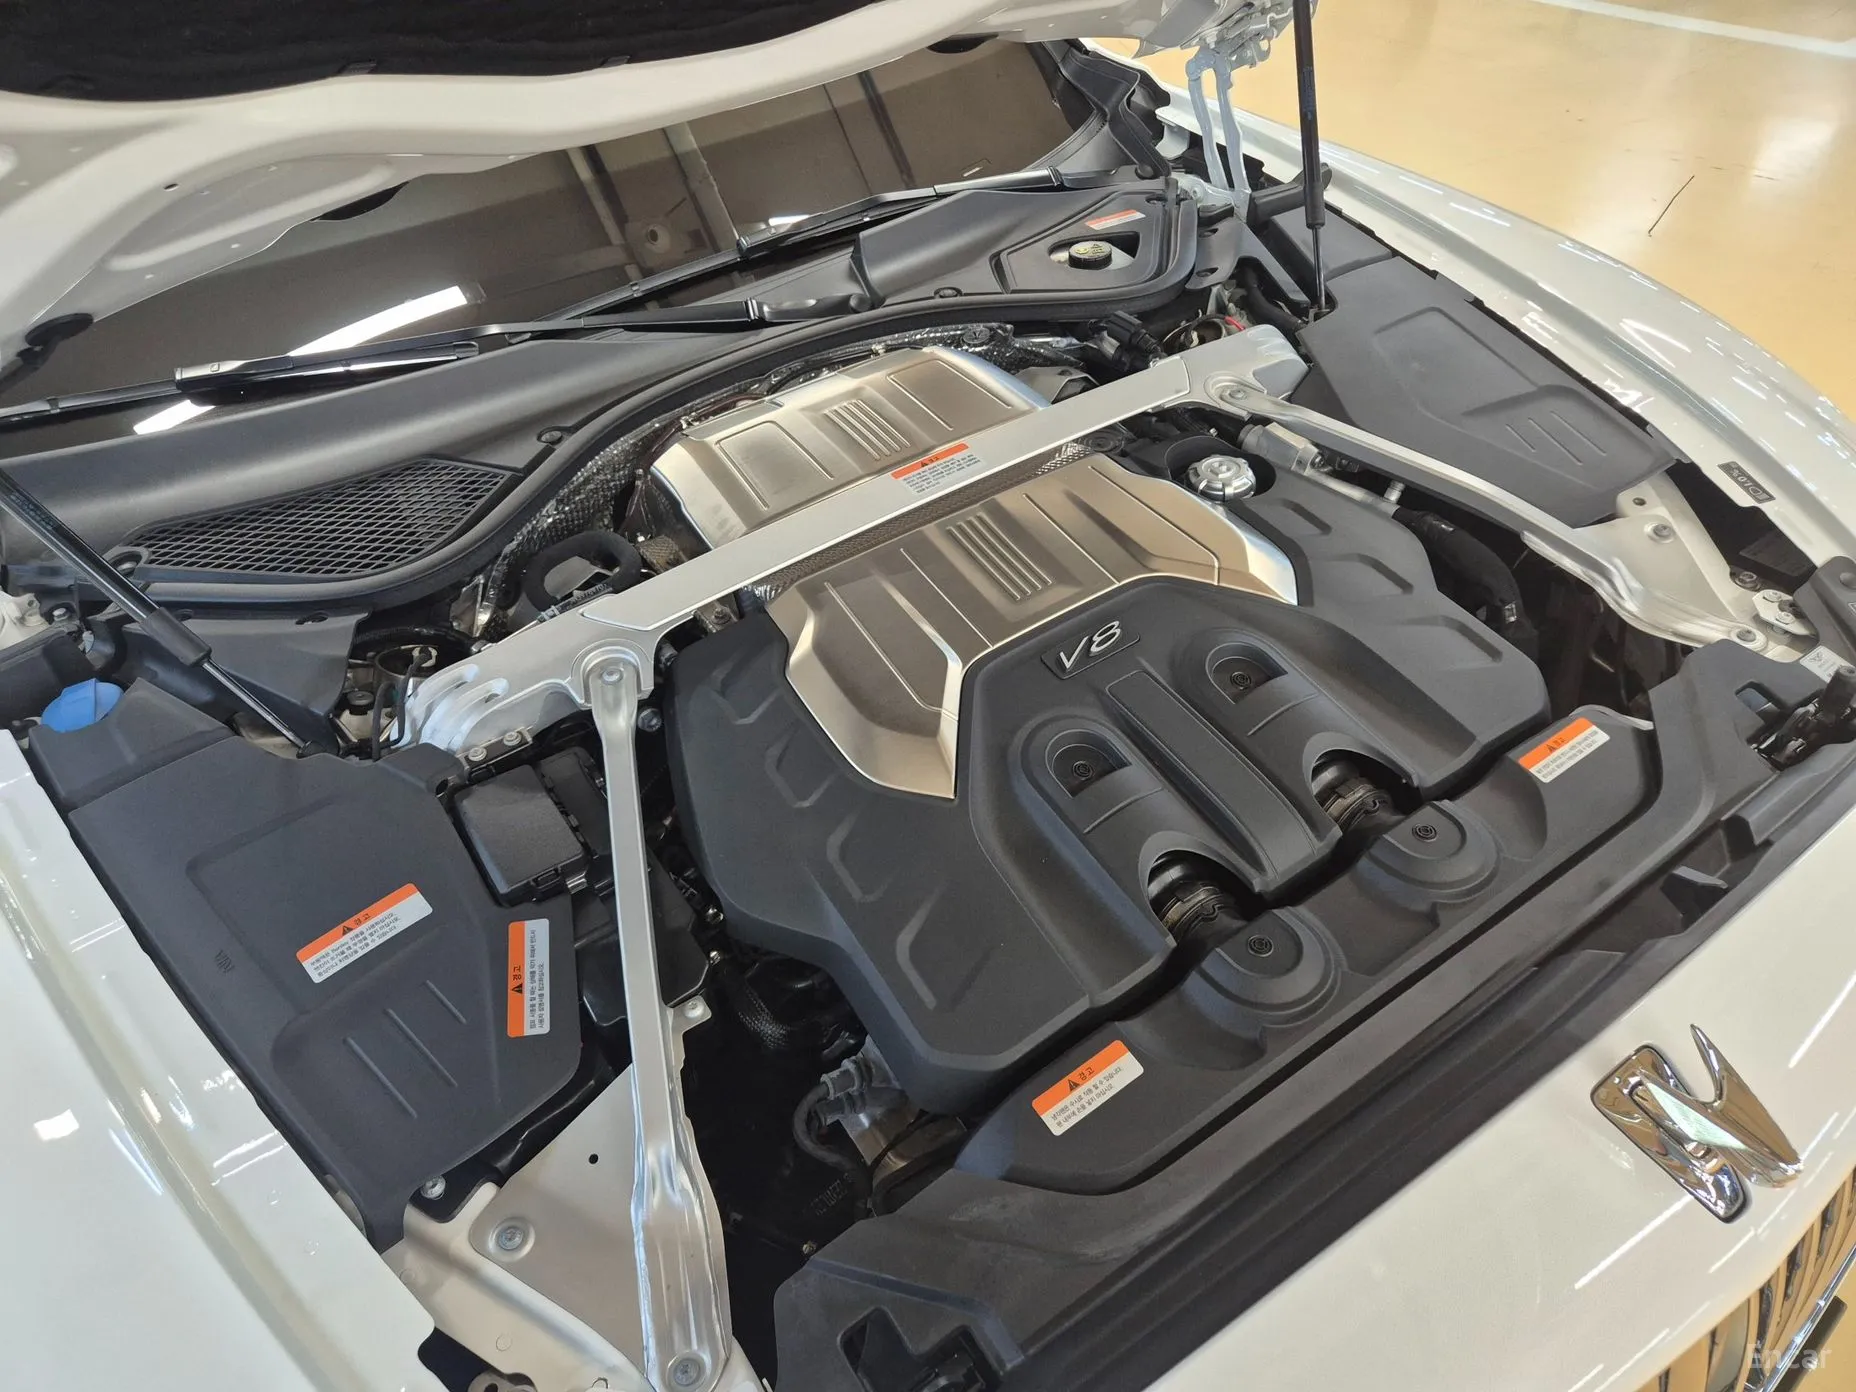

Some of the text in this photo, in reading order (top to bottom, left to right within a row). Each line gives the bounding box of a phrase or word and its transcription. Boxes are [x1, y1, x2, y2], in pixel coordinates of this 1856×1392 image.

[1059, 620, 1121, 669] V8
[354, 913, 371, 926] 경고
[513, 965, 521, 981] 경고
[1078, 1067, 1094, 1081] 경고
